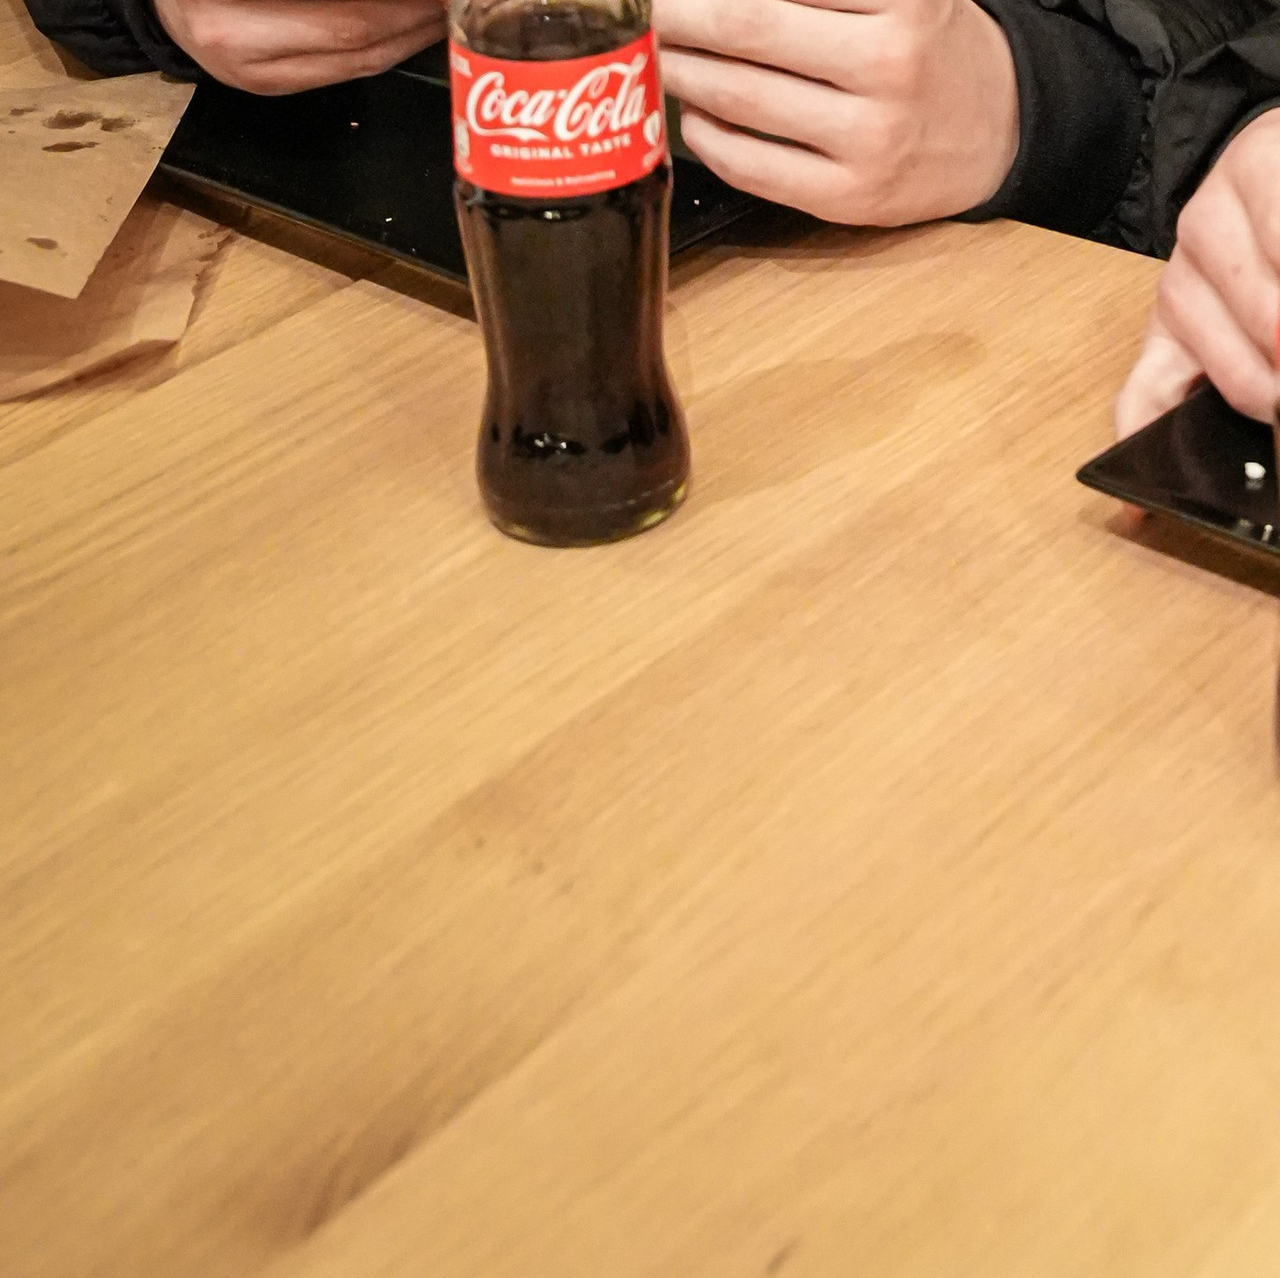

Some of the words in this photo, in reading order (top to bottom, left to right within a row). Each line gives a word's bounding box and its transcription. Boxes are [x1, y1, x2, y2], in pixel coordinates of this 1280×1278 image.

[465, 52, 649, 142] Coca-Cola
[489, 143, 574, 161] ORIGINAL
[580, 132, 632, 157] TASTE
